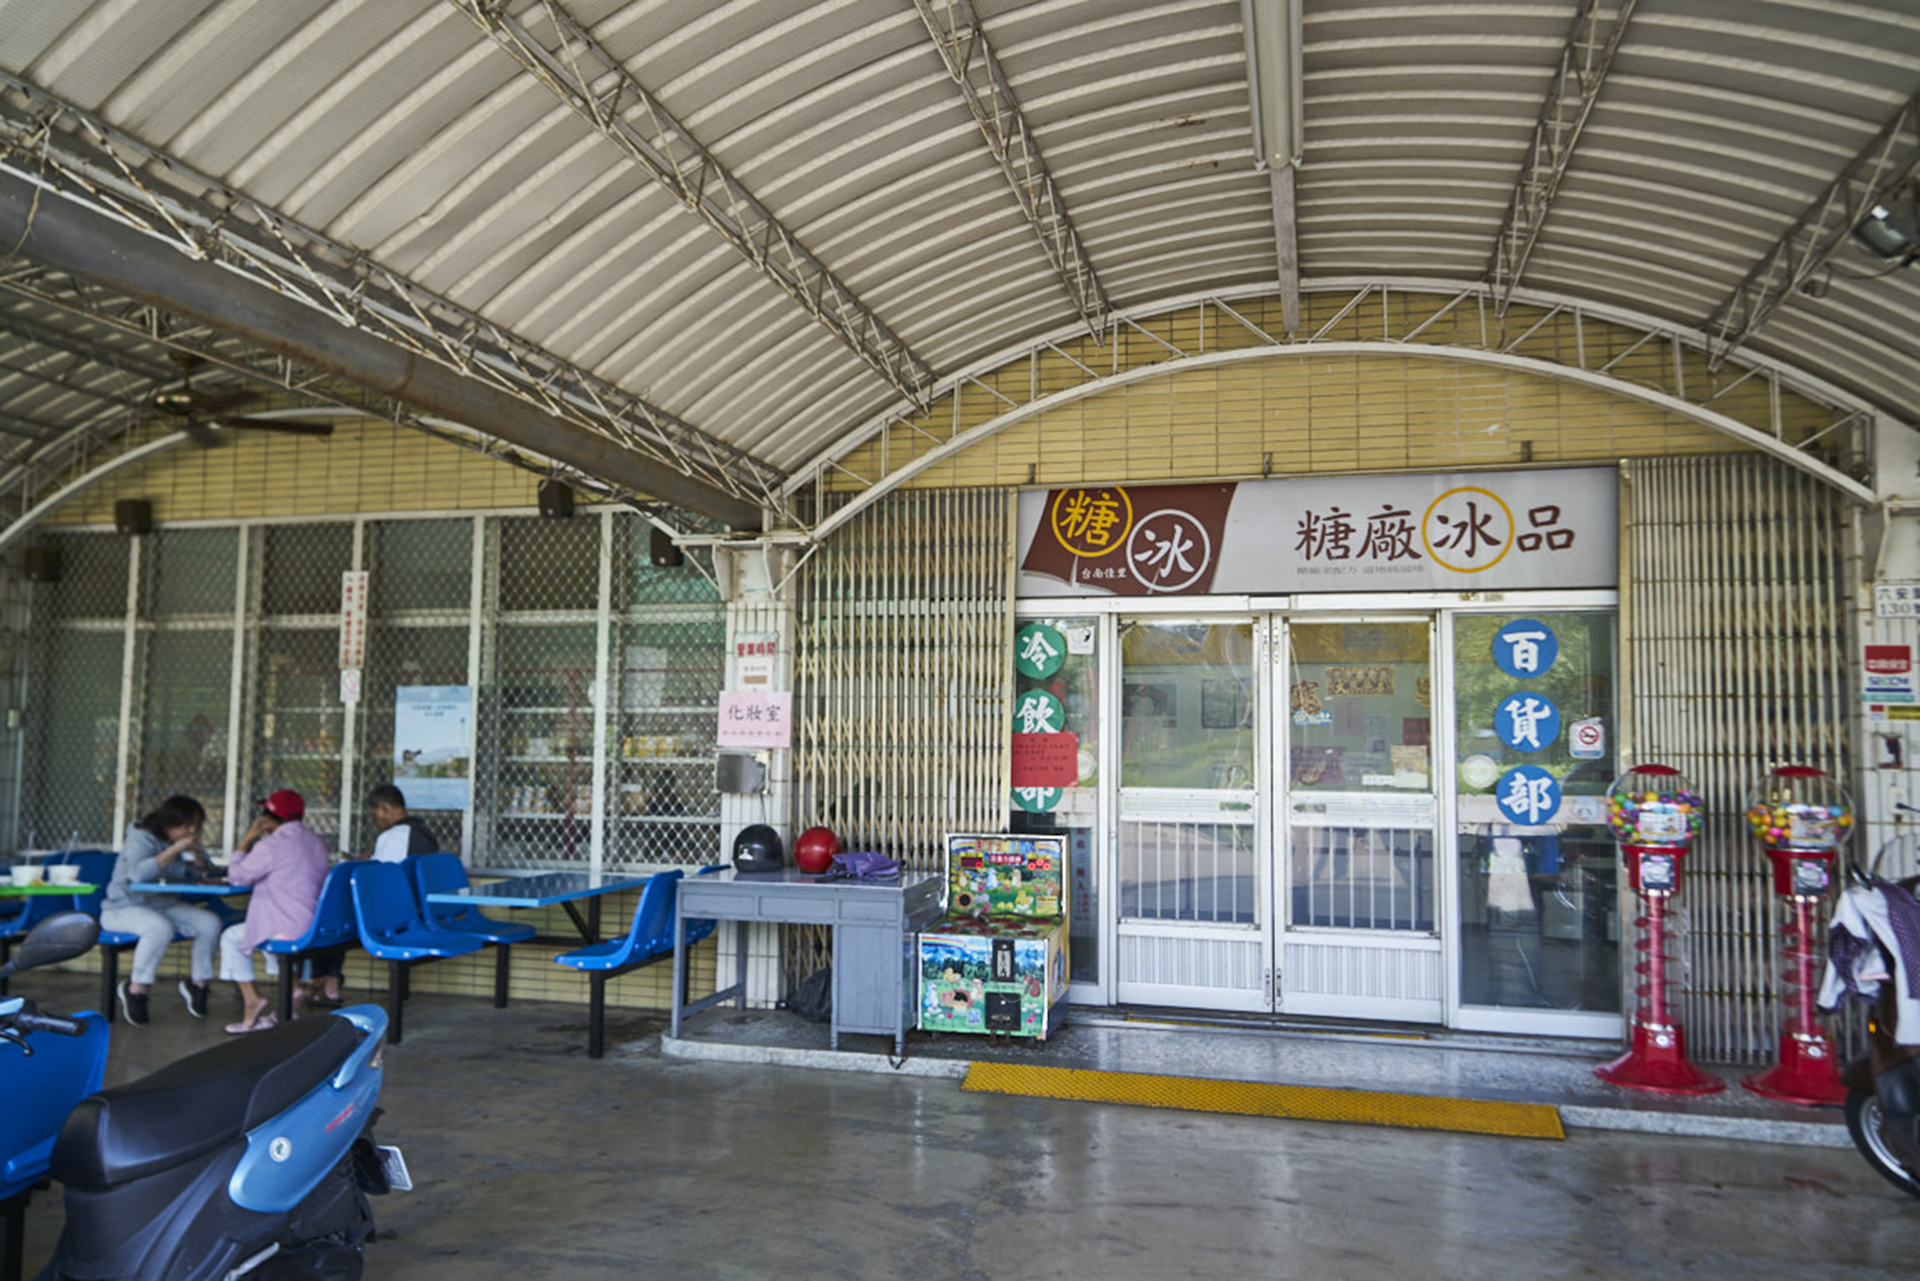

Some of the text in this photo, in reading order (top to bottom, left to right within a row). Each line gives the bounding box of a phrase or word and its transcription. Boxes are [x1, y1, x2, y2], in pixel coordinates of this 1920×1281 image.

[1294, 500, 1575, 561] 糖廠冰品
[1500, 630, 1553, 824] 百貨部
